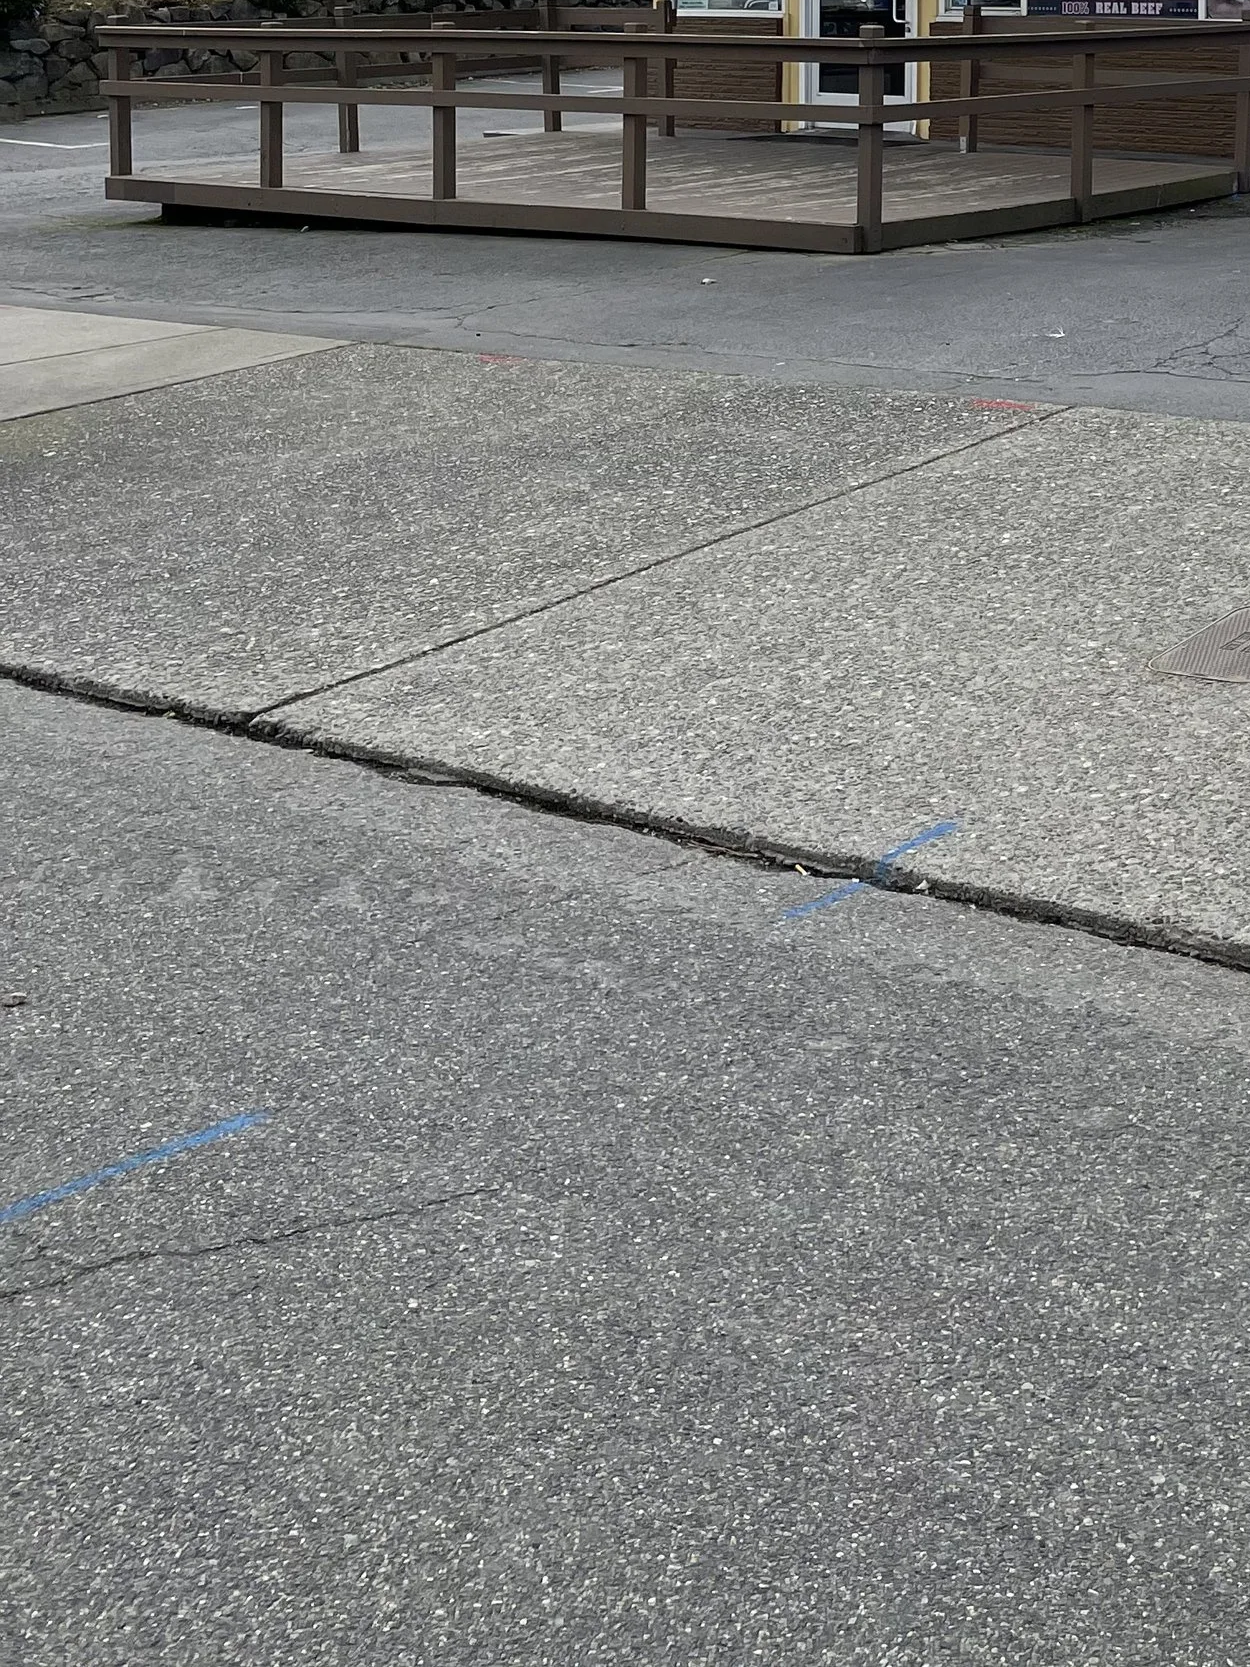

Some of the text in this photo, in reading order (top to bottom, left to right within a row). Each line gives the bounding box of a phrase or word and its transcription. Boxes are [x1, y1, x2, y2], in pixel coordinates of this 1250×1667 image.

[1061, 1, 1163, 15] 100% REAL BEEF
